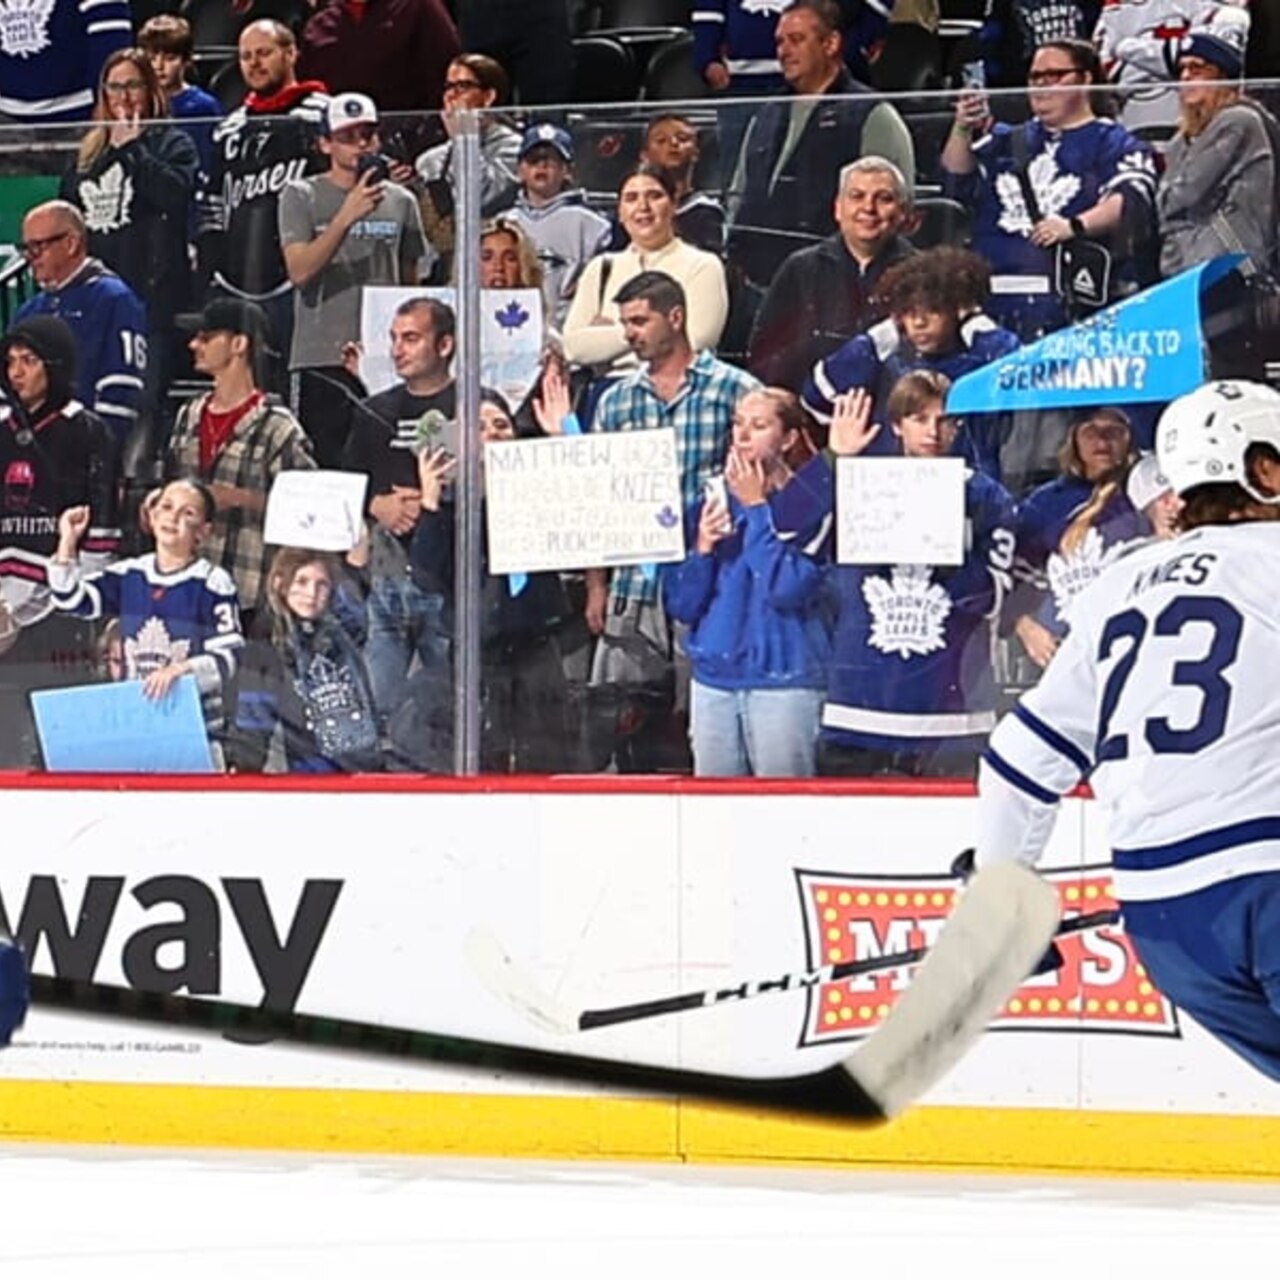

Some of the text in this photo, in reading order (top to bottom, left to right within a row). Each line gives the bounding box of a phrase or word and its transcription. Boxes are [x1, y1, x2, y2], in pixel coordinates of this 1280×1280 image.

[121, 331, 147, 368] 16
[1154, 330, 1181, 355] TO
[880, 594, 941, 616] TORONTO
[884, 623, 929, 637] LEAFS
[887, 612, 928, 626] MAPLE
[1096, 595, 1244, 762] 23
